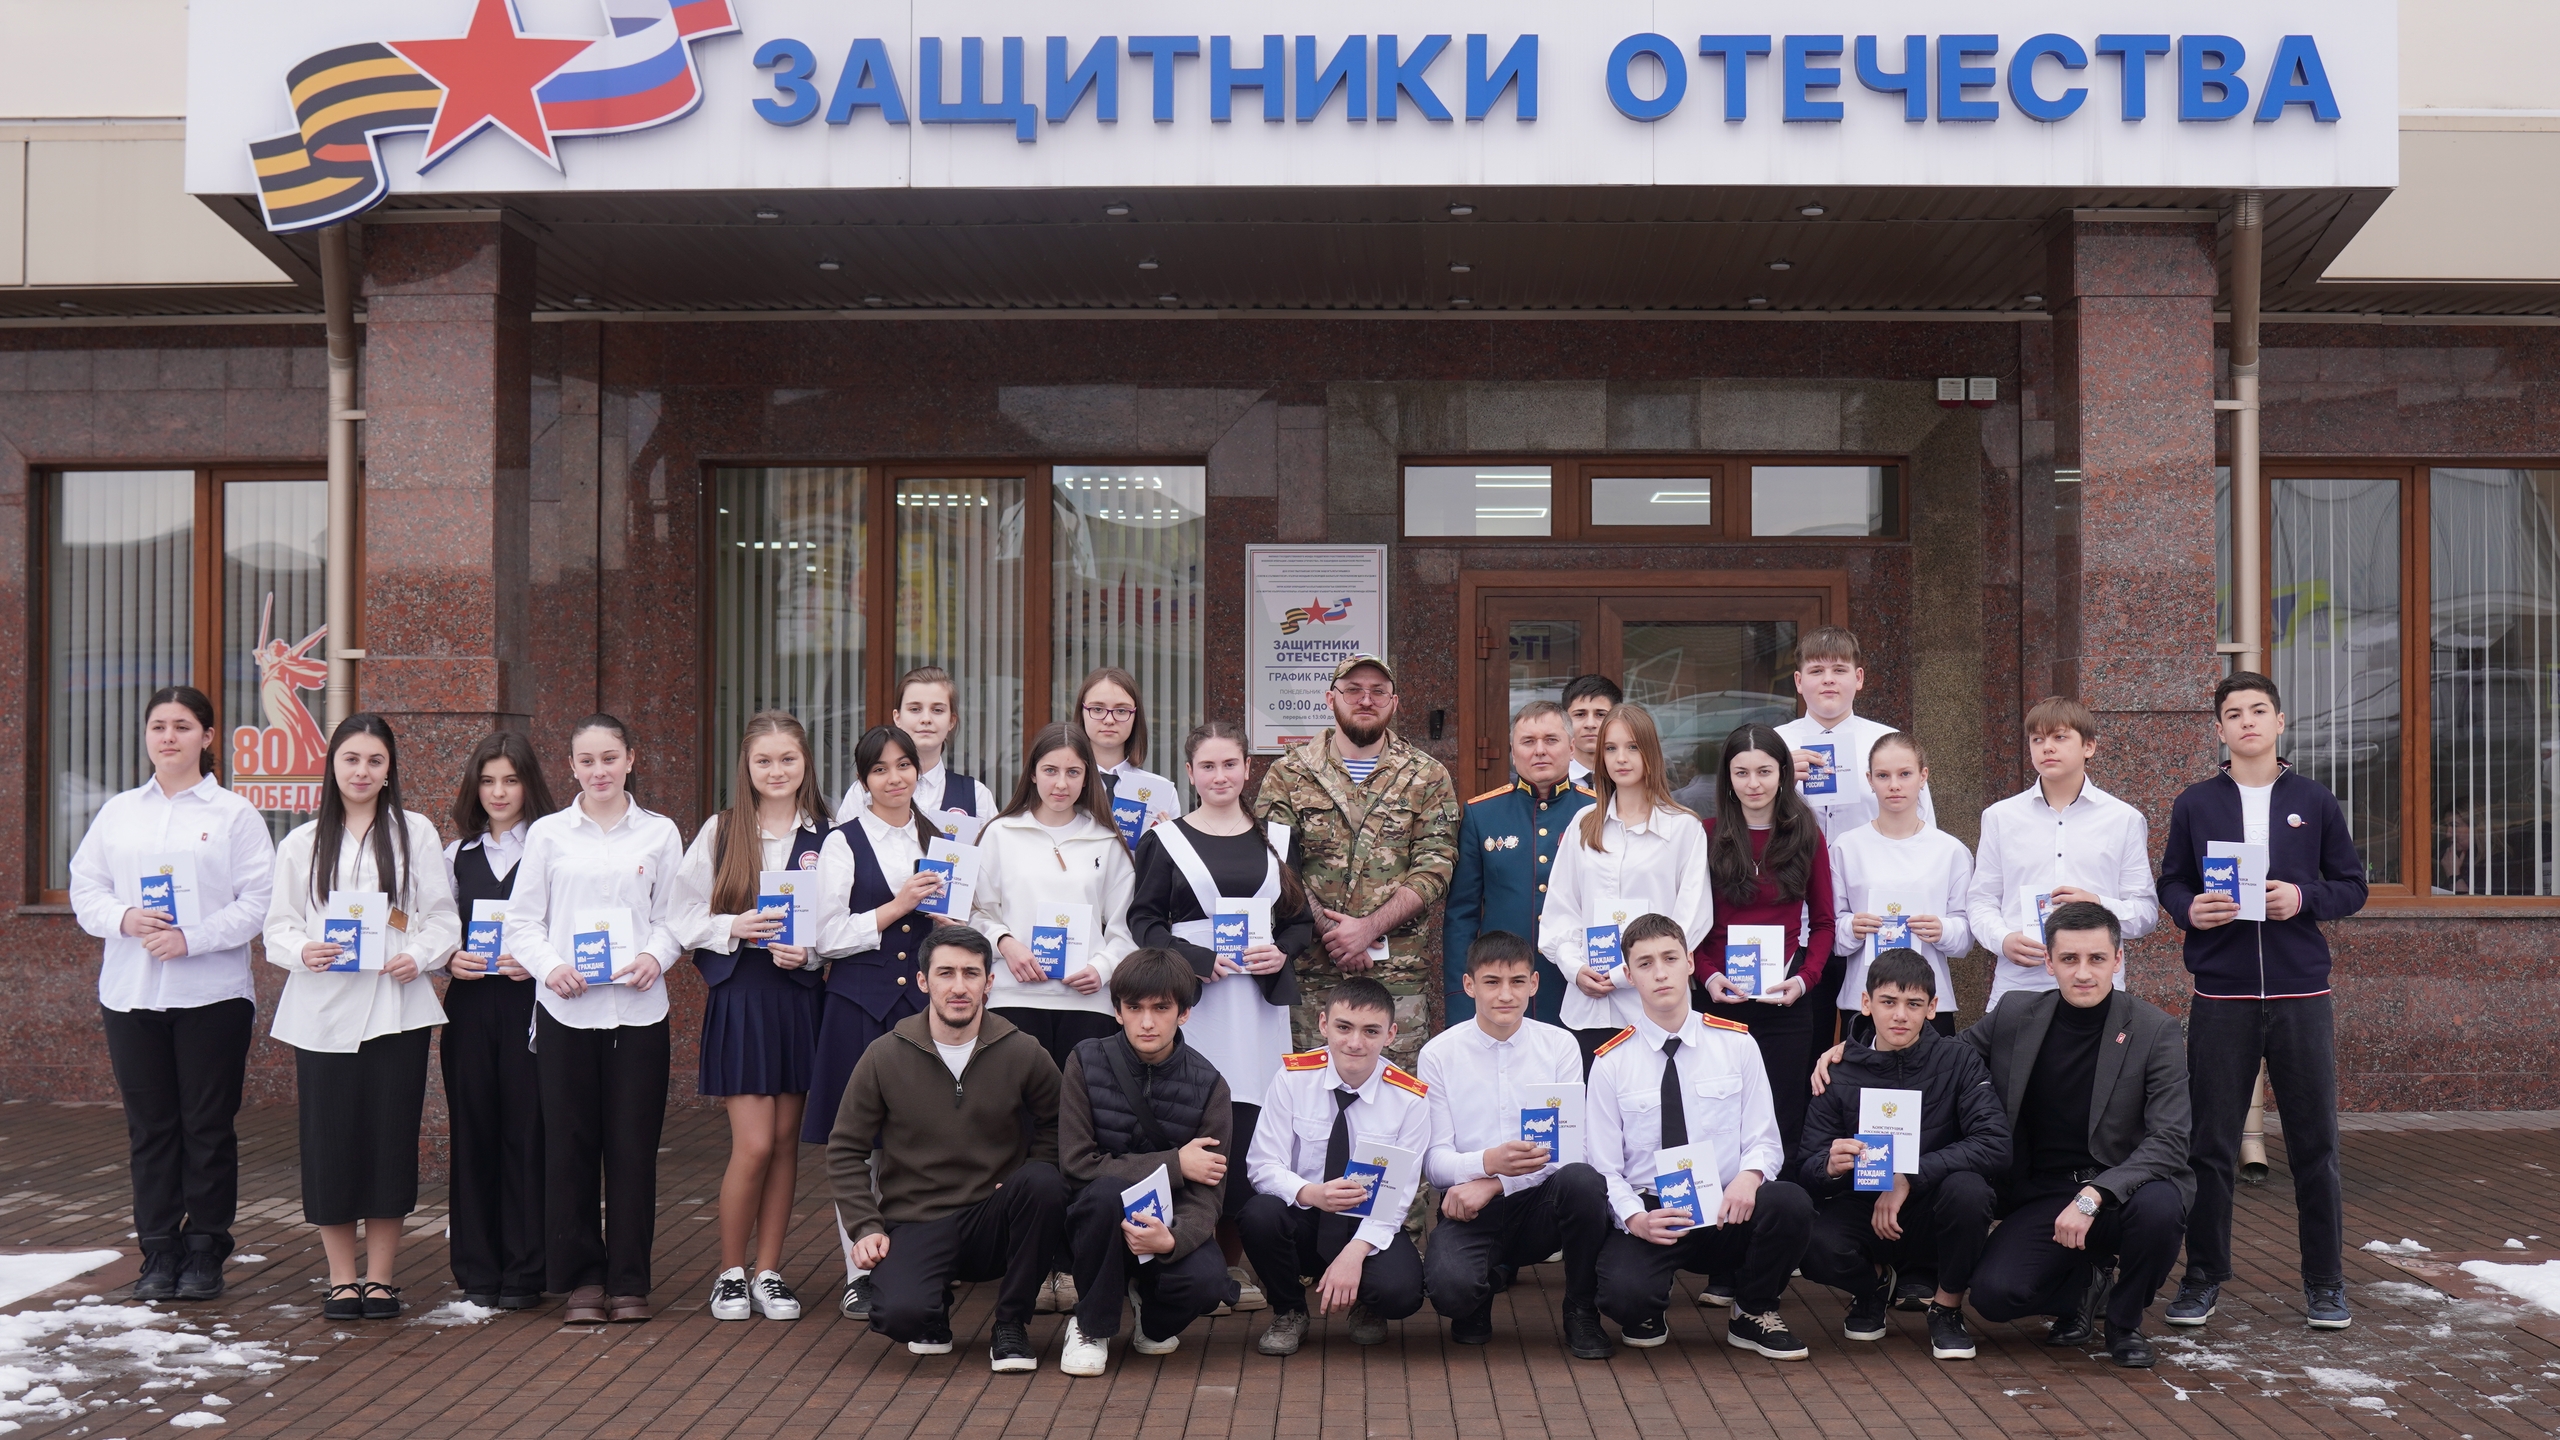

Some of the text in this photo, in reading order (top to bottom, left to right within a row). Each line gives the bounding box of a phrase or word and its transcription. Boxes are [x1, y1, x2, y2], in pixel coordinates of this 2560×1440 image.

[751, 32, 2342, 143] ЗАЩИТНИКИ ОТЕЧЕСТВА
[1273, 640, 1359, 651] ЗАЩИТНИКИ
[1269, 672, 1334, 681] ГРАФИК РАБ
[1278, 700, 1311, 710] 09:00
[1313, 703, 1328, 711] до
[234, 728, 288, 775] 80
[578, 962, 605, 970] ГРАЖДАНЕ
